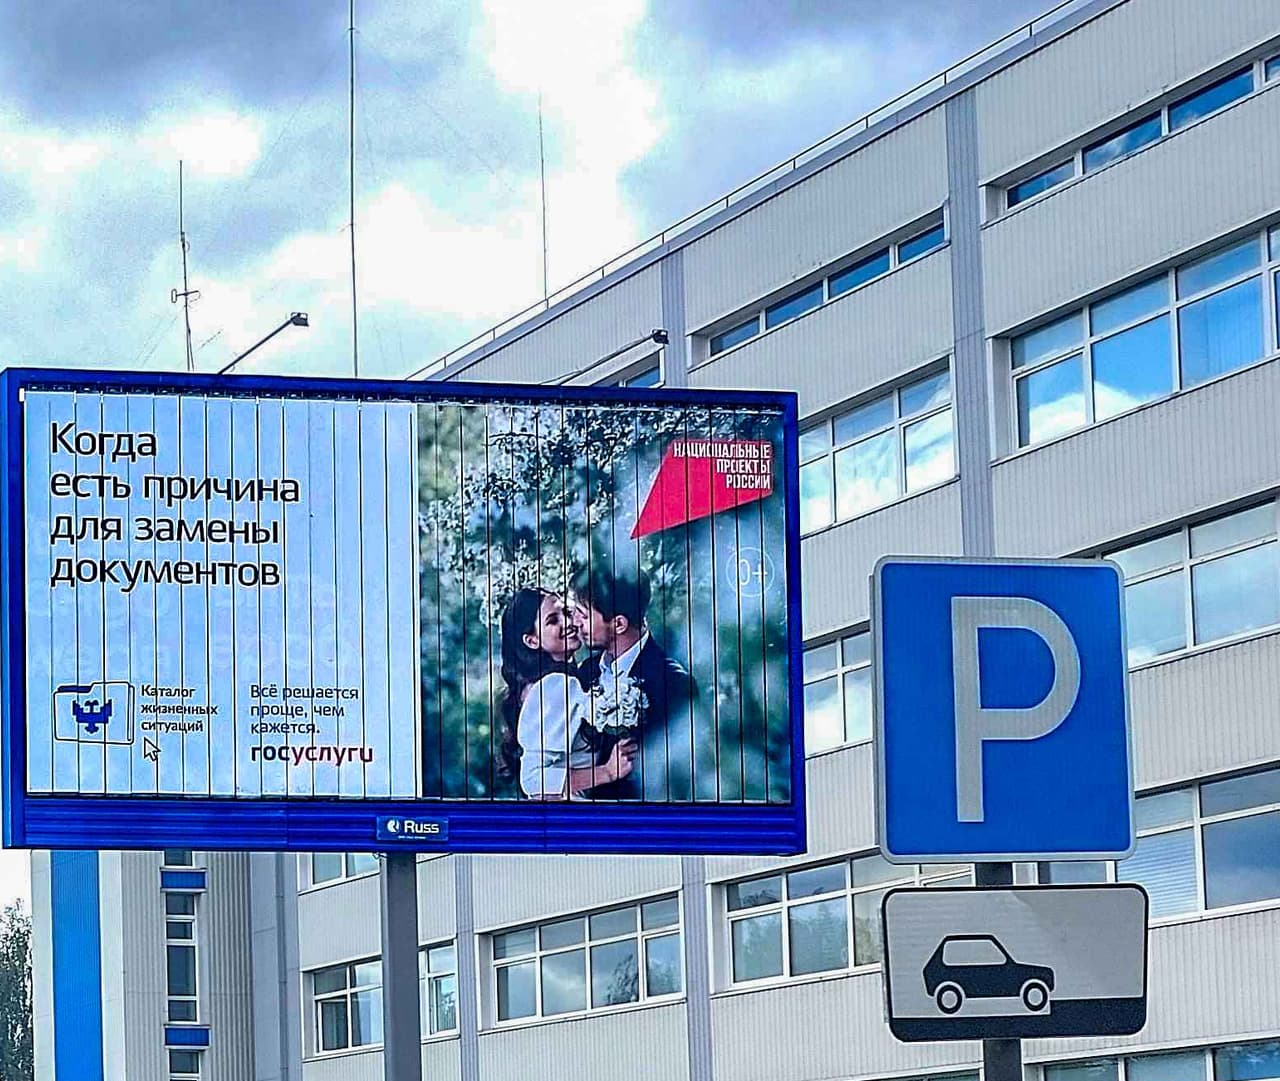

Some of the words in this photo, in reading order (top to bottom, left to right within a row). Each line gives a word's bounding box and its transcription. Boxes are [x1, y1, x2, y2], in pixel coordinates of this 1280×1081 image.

[51, 422, 157, 462] Когда
[673, 442, 771, 458] НАЦИОНАЛЬНЫЕ
[716, 459, 771, 474] ПРОЕКТЫ
[725, 474, 771, 489] РОССИИ
[50, 473, 131, 499] есть
[144, 474, 300, 508] причина
[50, 515, 123, 545] для
[134, 516, 280, 544] замены
[50, 558, 281, 593] документов
[737, 558, 768, 586] 0+
[141, 685, 196, 699] Каталог
[250, 684, 277, 699] Всё
[282, 687, 359, 705] решается
[140, 704, 219, 716] жизненных
[250, 704, 308, 721] проще,
[314, 705, 345, 717] чем
[951, 595, 1081, 822] P
[141, 719, 204, 733] ситуаций
[250, 721, 321, 734] кажется.
[404, 820, 440, 834] Russ
